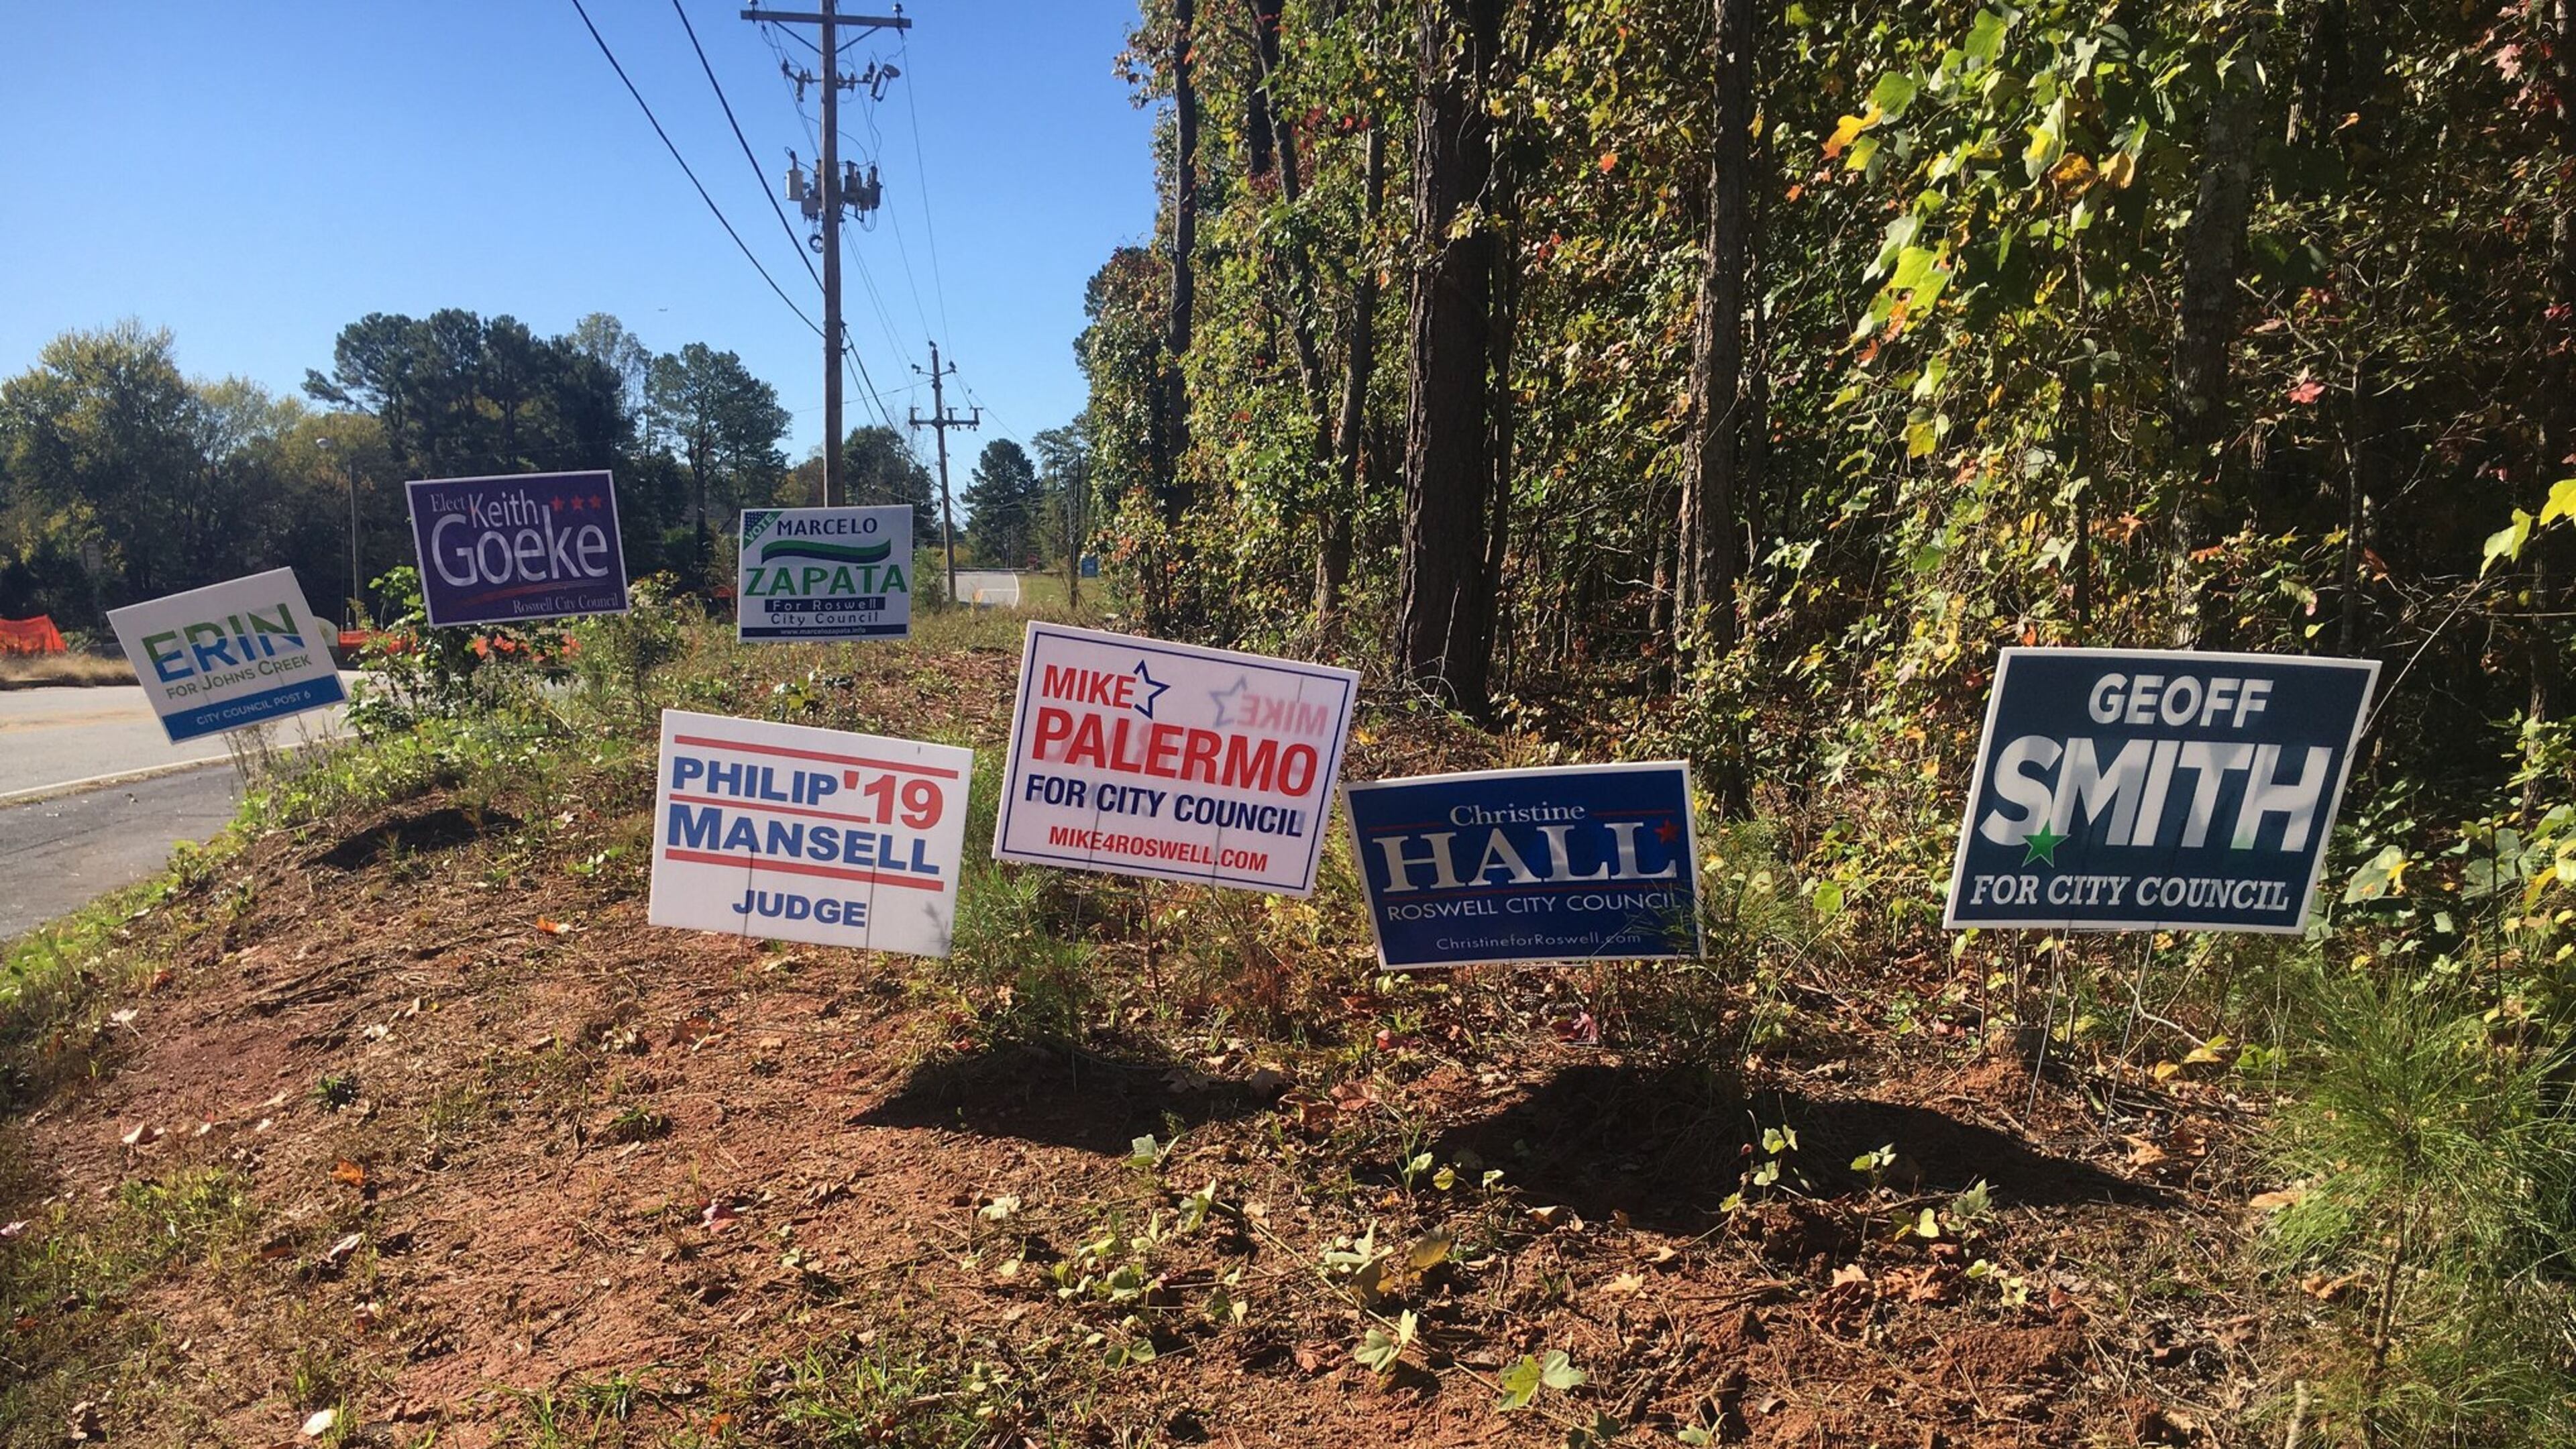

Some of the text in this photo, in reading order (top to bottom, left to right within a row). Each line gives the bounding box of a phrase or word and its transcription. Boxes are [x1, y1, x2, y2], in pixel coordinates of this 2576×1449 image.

[431, 489, 538, 528] Elect Keith
[745, 513, 777, 541] VOTE
[777, 517, 877, 536] MARCELO
[431, 504, 608, 586] Goeke
[744, 564, 908, 596] ZAPATA
[513, 593, 619, 613] Roswell City Council
[771, 612, 878, 626] City Council
[773, 598, 876, 611] For Roswell
[142, 603, 305, 683] ERIN
[780, 627, 866, 635] www.marcelozapata.info
[166, 654, 312, 700] FOR JOHNS CREEK
[1041, 664, 1136, 709] MIKE
[197, 690, 311, 725] CITY COUNCIL POST 6
[2089, 673, 2273, 729] GEOFF
[1032, 706, 1318, 798] PALERMO
[672, 756, 944, 830] PHILIP '19
[1025, 774, 1303, 837] FOR CITY COUNCIL
[1979, 735, 2333, 852] SMITH
[1449, 802, 1585, 826] Christine
[667, 803, 940, 875] MANSELL
[1049, 826, 1268, 872] MIKE4ROSWELL.COM
[1373, 822, 1677, 893] HALL
[733, 890, 867, 928] JUDGE
[1387, 892, 1680, 921] ROSWELL CITY COUNCIL
[1970, 875, 2290, 911] FOR CITY COUNCIL
[1436, 932, 1642, 951] ChristineforRoswell.com
